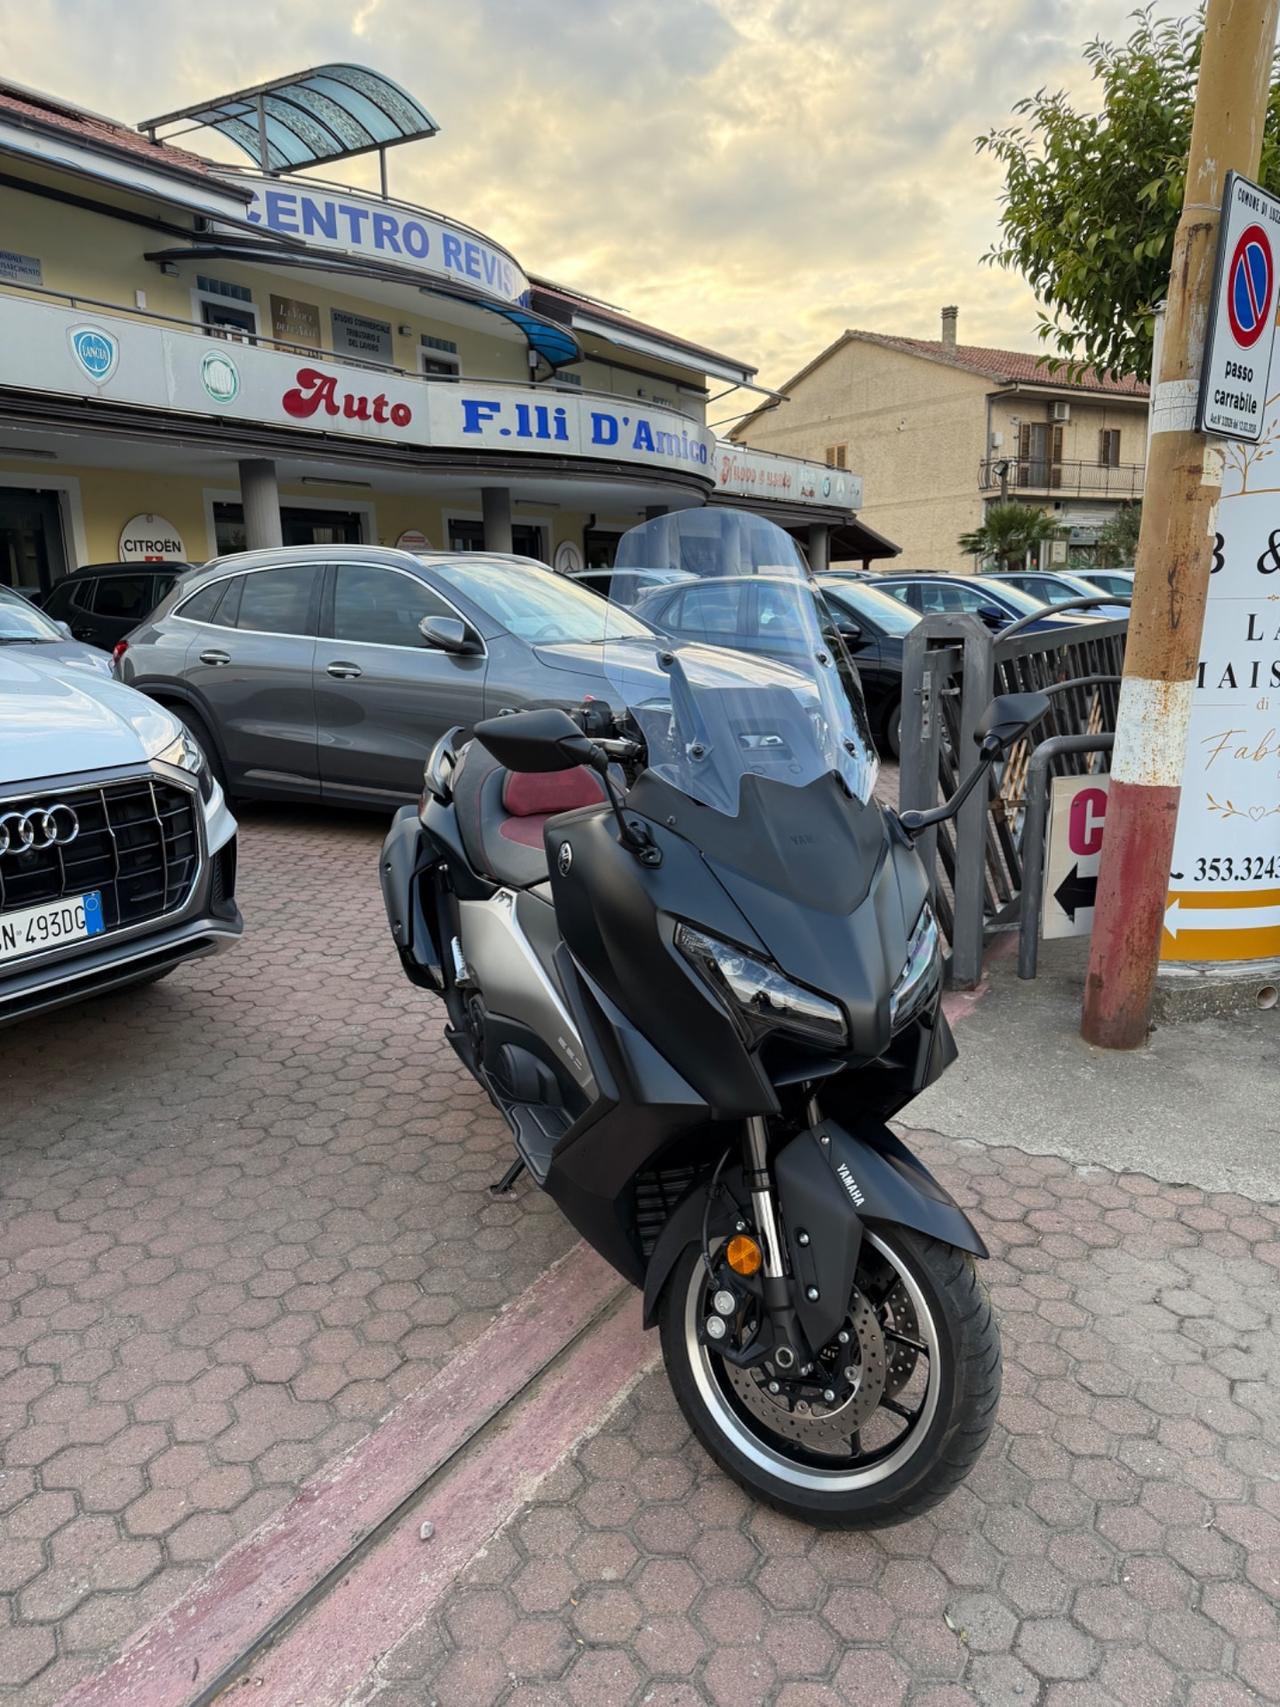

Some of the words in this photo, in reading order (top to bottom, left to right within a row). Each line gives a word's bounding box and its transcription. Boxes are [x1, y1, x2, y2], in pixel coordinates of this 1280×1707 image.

[1261, 201, 1268, 216] DI
[1225, 360, 1253, 382] passo
[1214, 389, 1257, 414] carrabile
[282, 368, 412, 427] Auto
[461, 400, 569, 440] F.lli
[591, 411, 707, 465] D'Amico
[124, 539, 181, 552] CITROËN
[1256, 697, 1269, 711] di
[1201, 728, 1280, 771] Fab
[837, 1163, 865, 1207] YAMAHA
